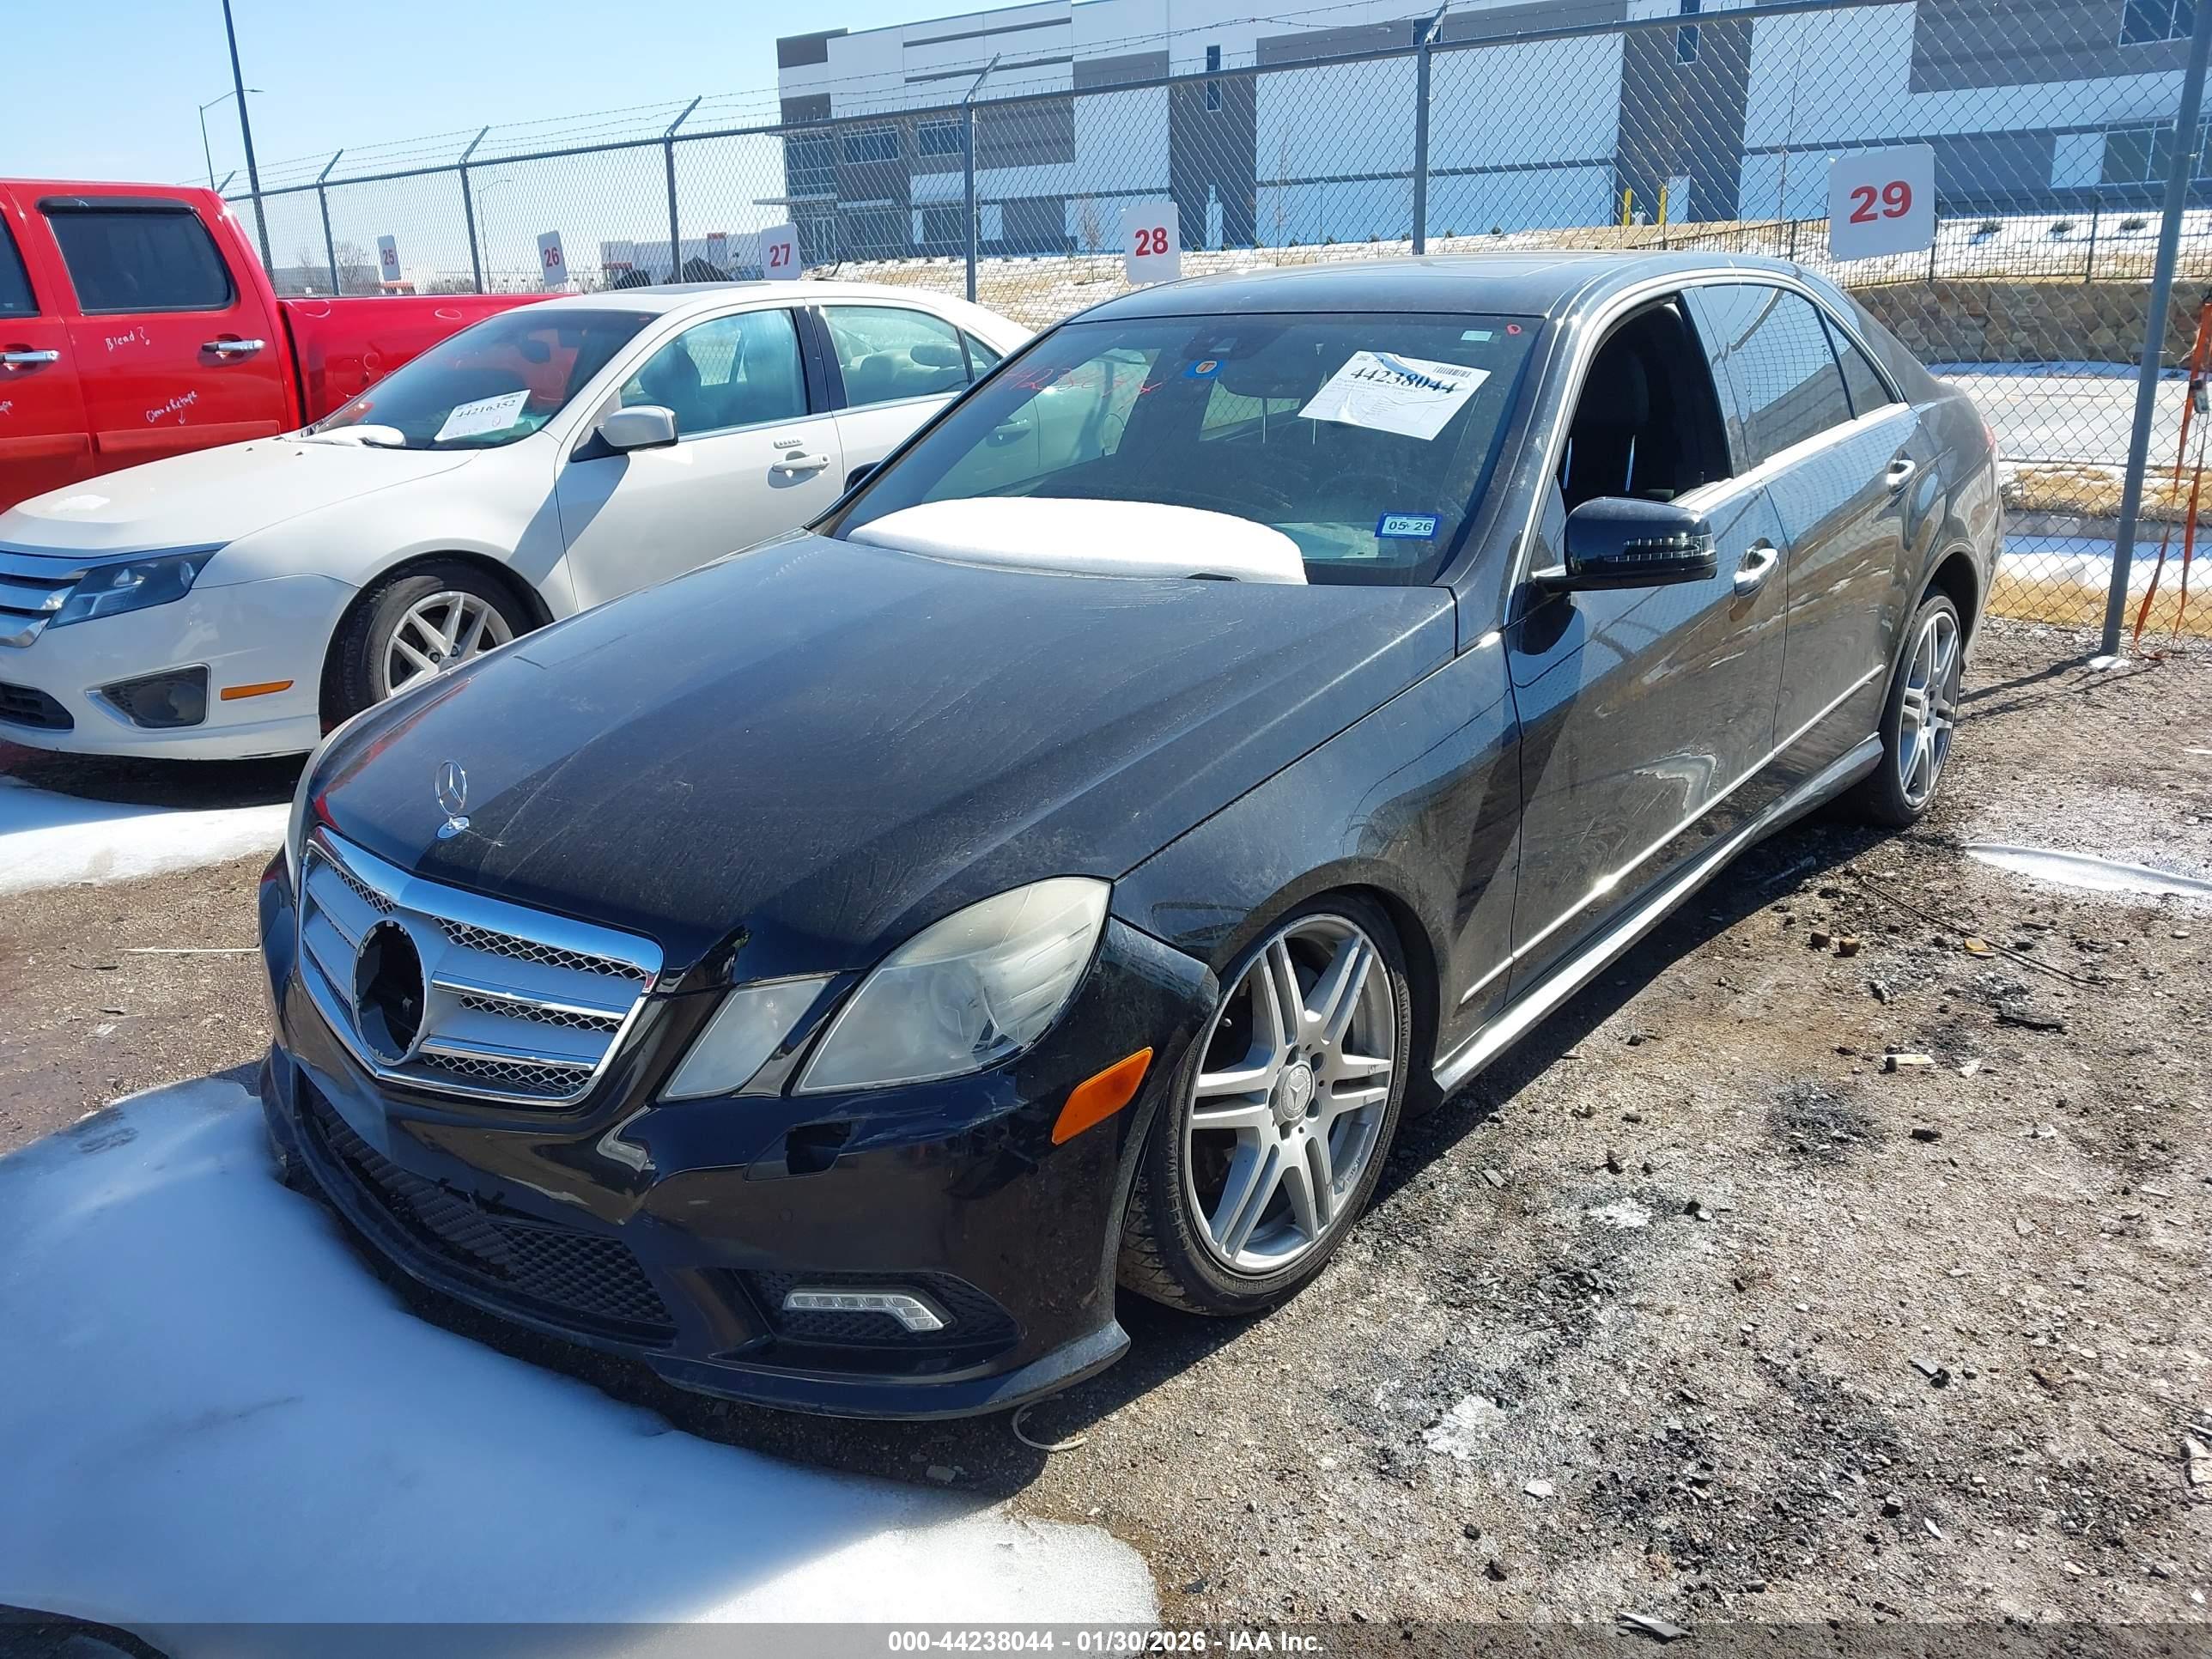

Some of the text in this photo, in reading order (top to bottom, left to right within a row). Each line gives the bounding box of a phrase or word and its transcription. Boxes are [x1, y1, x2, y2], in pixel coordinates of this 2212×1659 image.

[1850, 180, 1912, 224] 29
[1134, 227, 1169, 257] 28
[383, 249, 395, 266] 25
[544, 246, 559, 268] 26
[769, 243, 791, 267] 27
[1350, 366, 1458, 394] 44238044
[1389, 520, 1432, 532] 05 26
